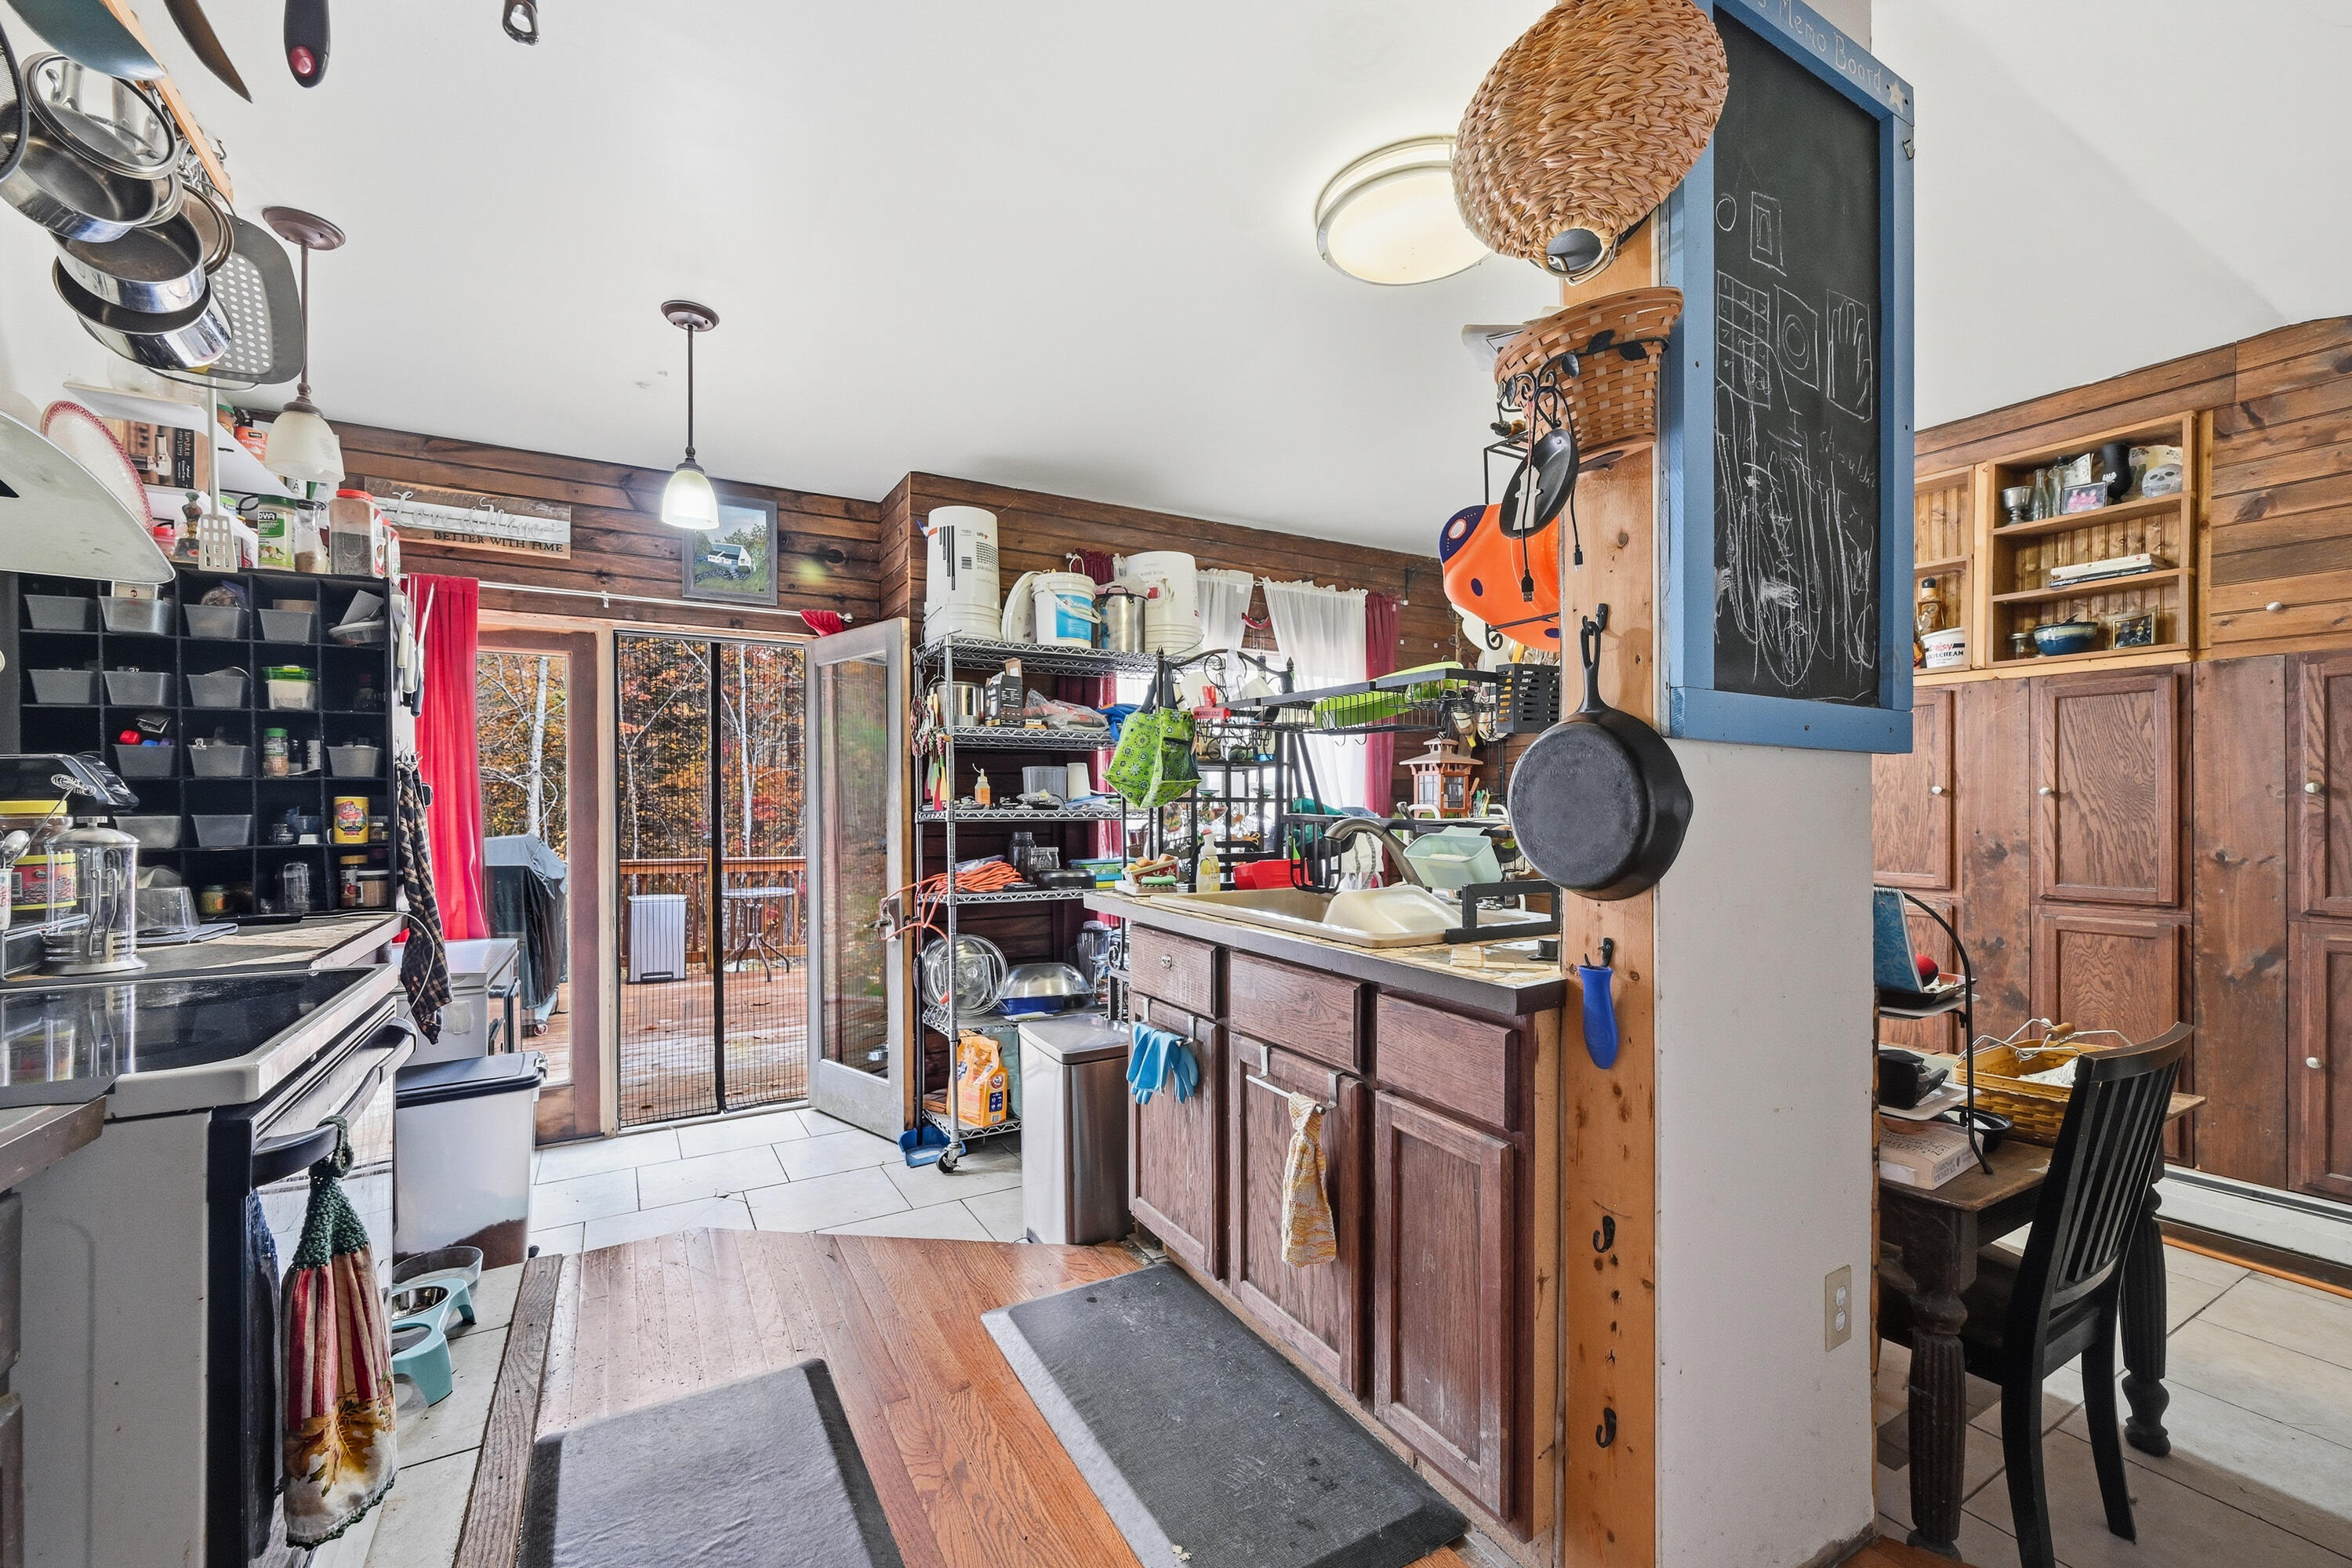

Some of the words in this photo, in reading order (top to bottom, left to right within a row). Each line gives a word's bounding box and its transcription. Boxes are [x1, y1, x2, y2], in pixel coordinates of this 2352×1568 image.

[1779, 0, 1827, 53] Memo
[1833, 31, 1882, 95] Board
[434, 531, 485, 544] BETTER
[489, 536, 525, 549] WITH
[529, 541, 564, 553] TIME
